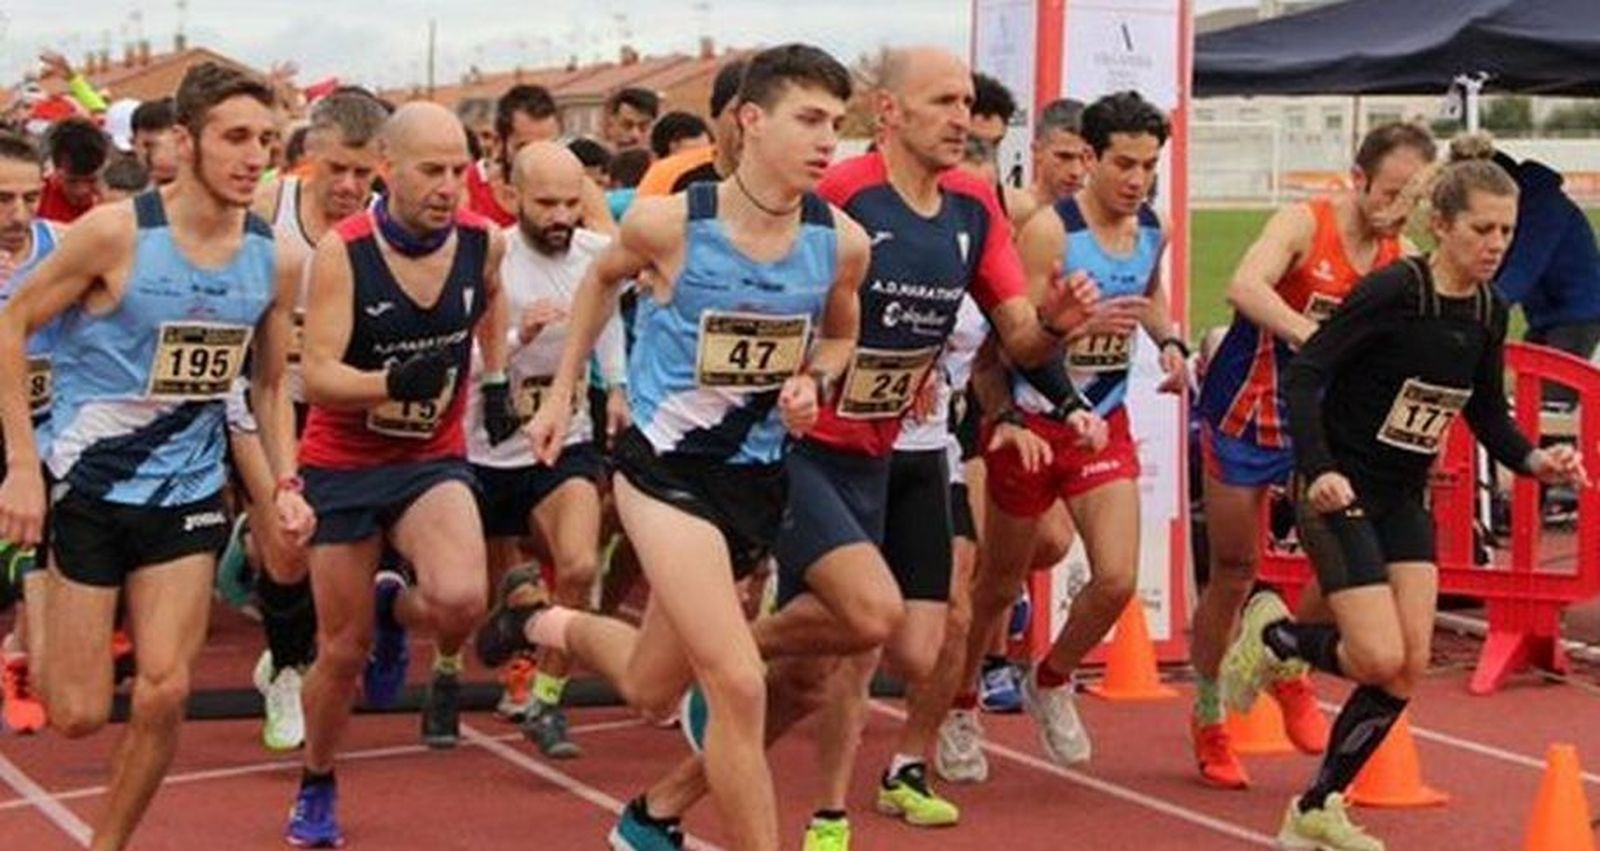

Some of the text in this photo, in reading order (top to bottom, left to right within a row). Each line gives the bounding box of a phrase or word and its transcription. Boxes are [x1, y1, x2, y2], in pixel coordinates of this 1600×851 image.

[170, 348, 230, 378] 195
[728, 339, 777, 370] 47
[871, 372, 912, 399] 24
